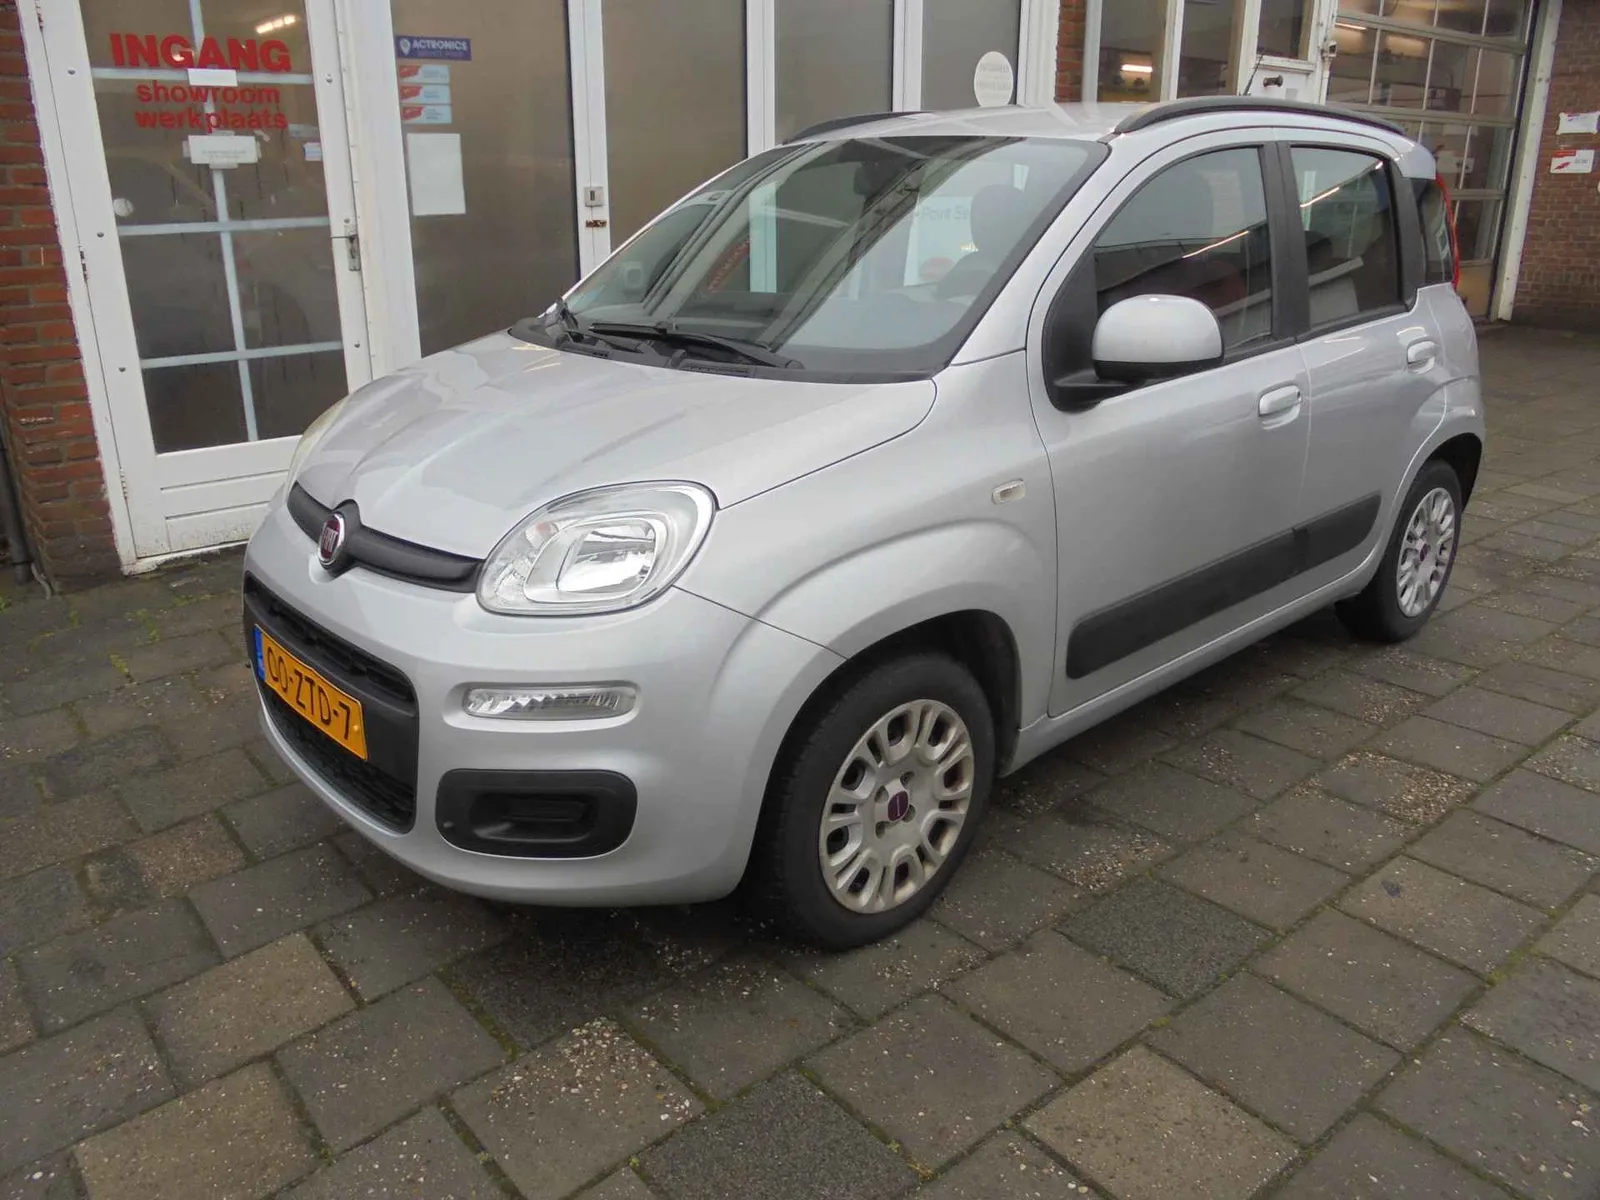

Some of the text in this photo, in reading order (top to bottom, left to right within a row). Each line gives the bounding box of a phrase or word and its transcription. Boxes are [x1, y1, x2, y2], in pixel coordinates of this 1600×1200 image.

[109, 33, 292, 72] INGANG
[412, 39, 468, 52] ACTRONICS
[137, 80, 280, 104] showroom
[134, 107, 288, 133] werkplaats
